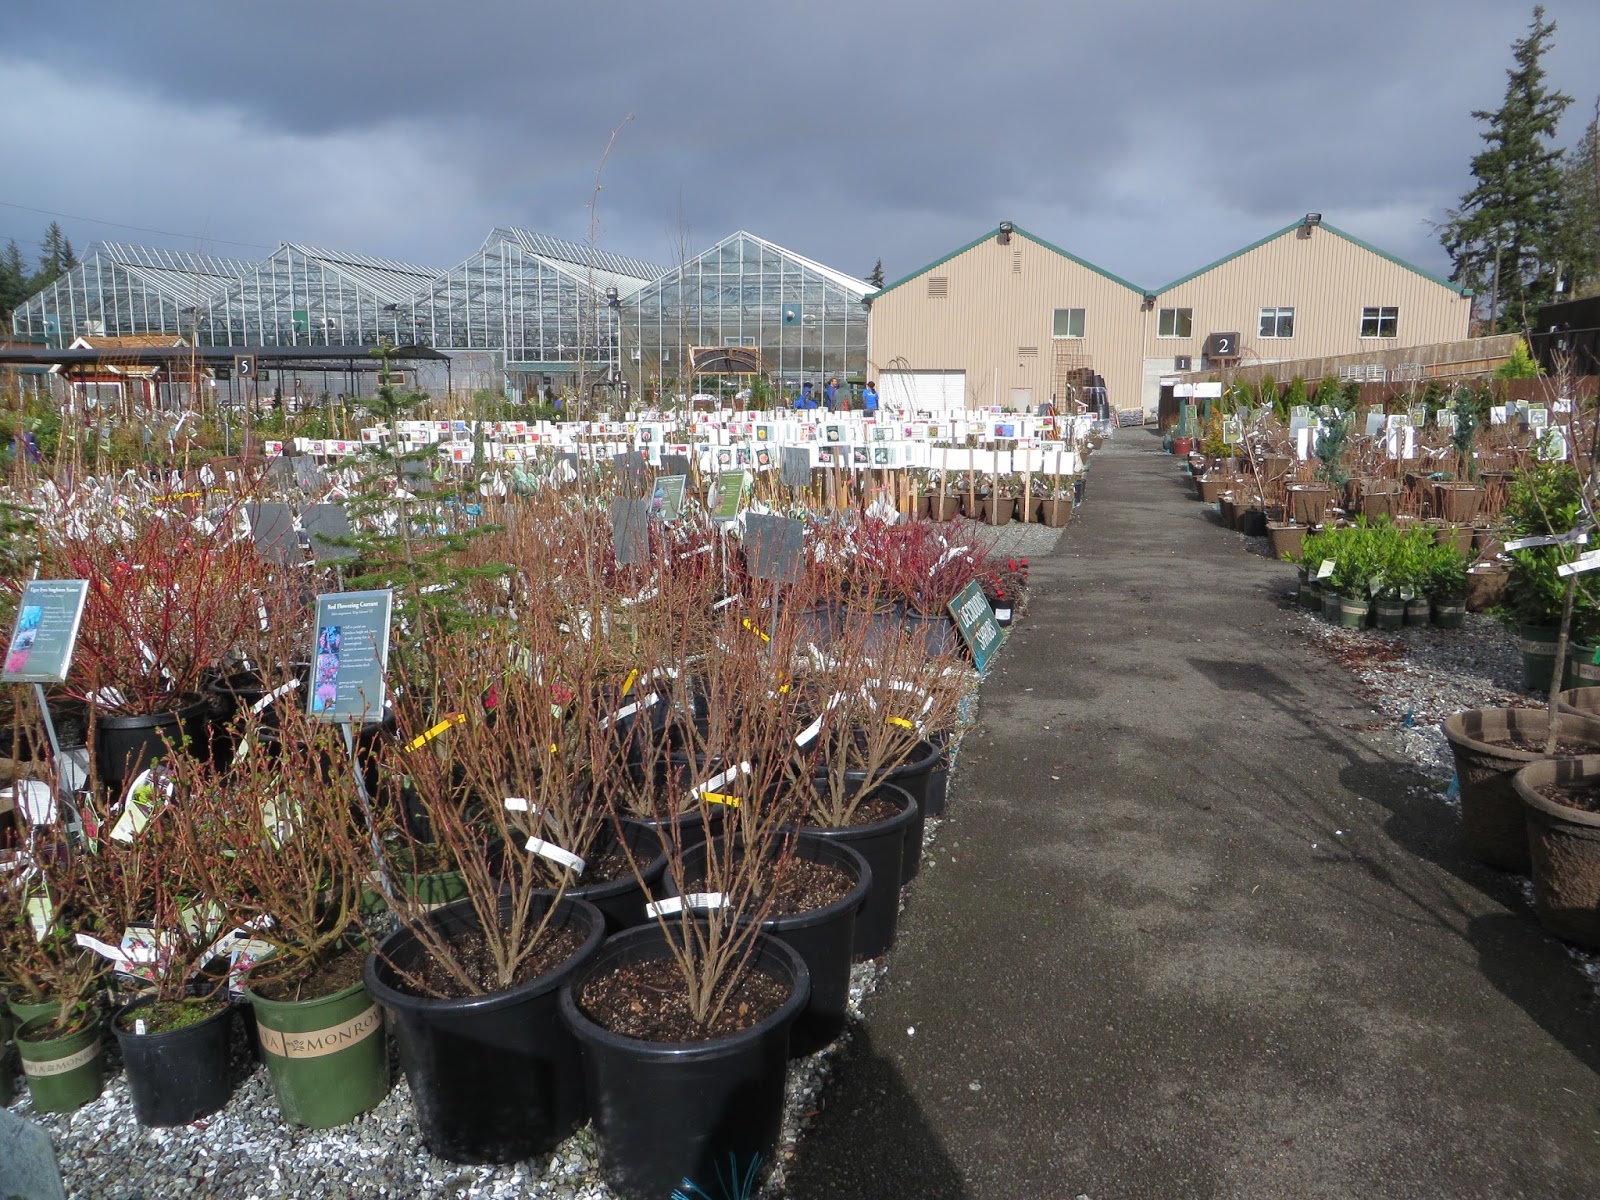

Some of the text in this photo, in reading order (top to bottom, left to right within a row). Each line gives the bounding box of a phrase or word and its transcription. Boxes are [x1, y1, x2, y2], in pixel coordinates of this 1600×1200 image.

[1218, 338, 1228, 352] 2
[242, 360, 248, 374] 5
[1180, 360, 1185, 368] 1
[614, 373, 619, 382] 4
